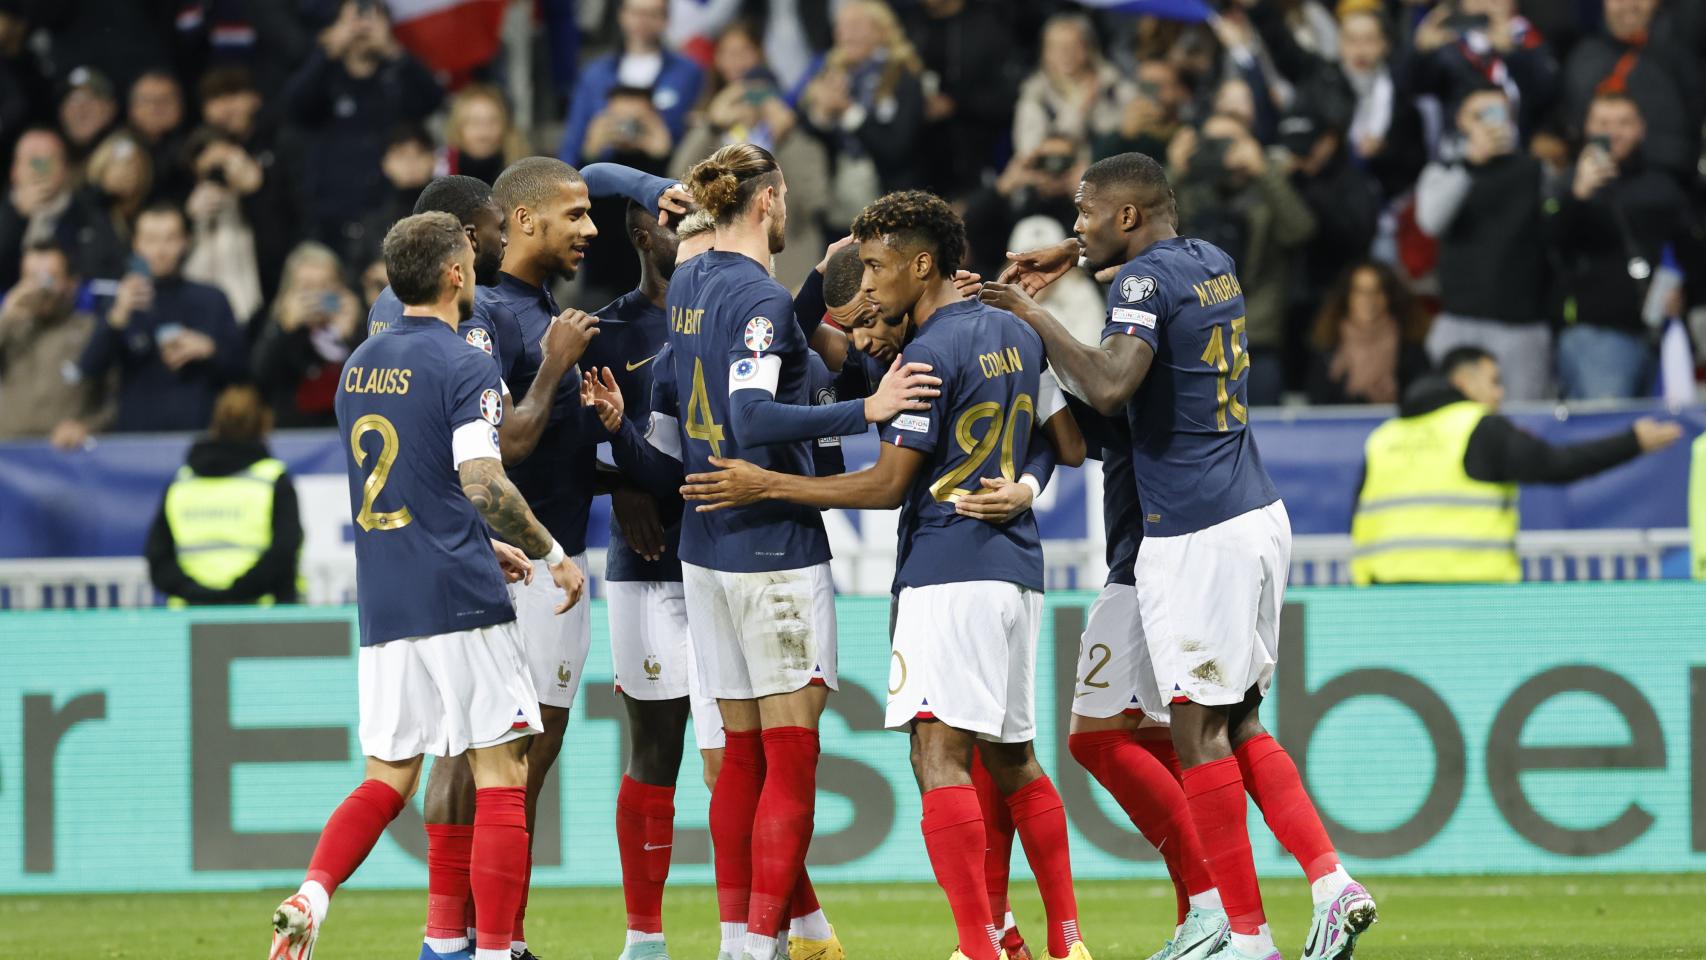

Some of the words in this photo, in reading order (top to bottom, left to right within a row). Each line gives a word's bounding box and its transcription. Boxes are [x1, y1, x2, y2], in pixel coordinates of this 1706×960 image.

[671, 305, 705, 336] RABT
[1192, 272, 1243, 308] M.THURA
[344, 366, 412, 395] CLAUSS
[685, 356, 726, 458] 4
[1200, 316, 1250, 432] 15
[351, 413, 414, 533] 2
[928, 393, 1034, 504] 20
[1076, 642, 1112, 689] 2
[190, 620, 897, 874] Es
[1053, 602, 1706, 862] Ube
